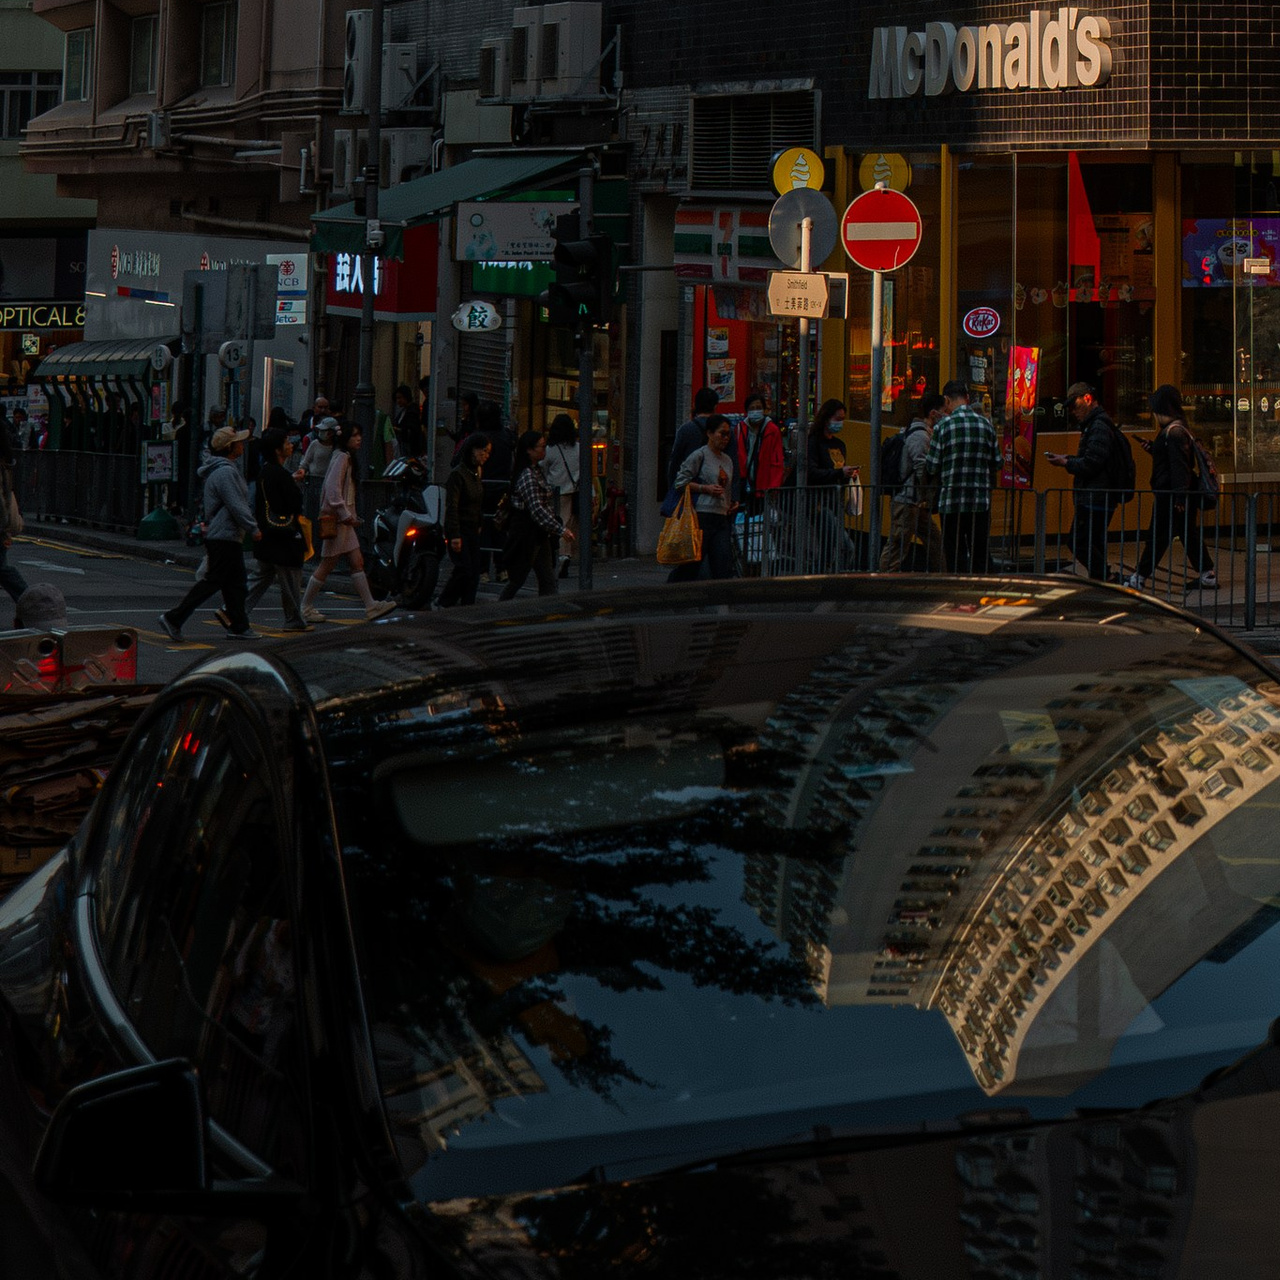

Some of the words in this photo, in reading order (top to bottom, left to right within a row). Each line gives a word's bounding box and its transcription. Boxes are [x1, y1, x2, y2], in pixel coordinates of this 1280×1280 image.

[868, 6, 1113, 100] McDonald's
[467, 305, 489, 330] 餃
[226, 347, 240, 362] 13
